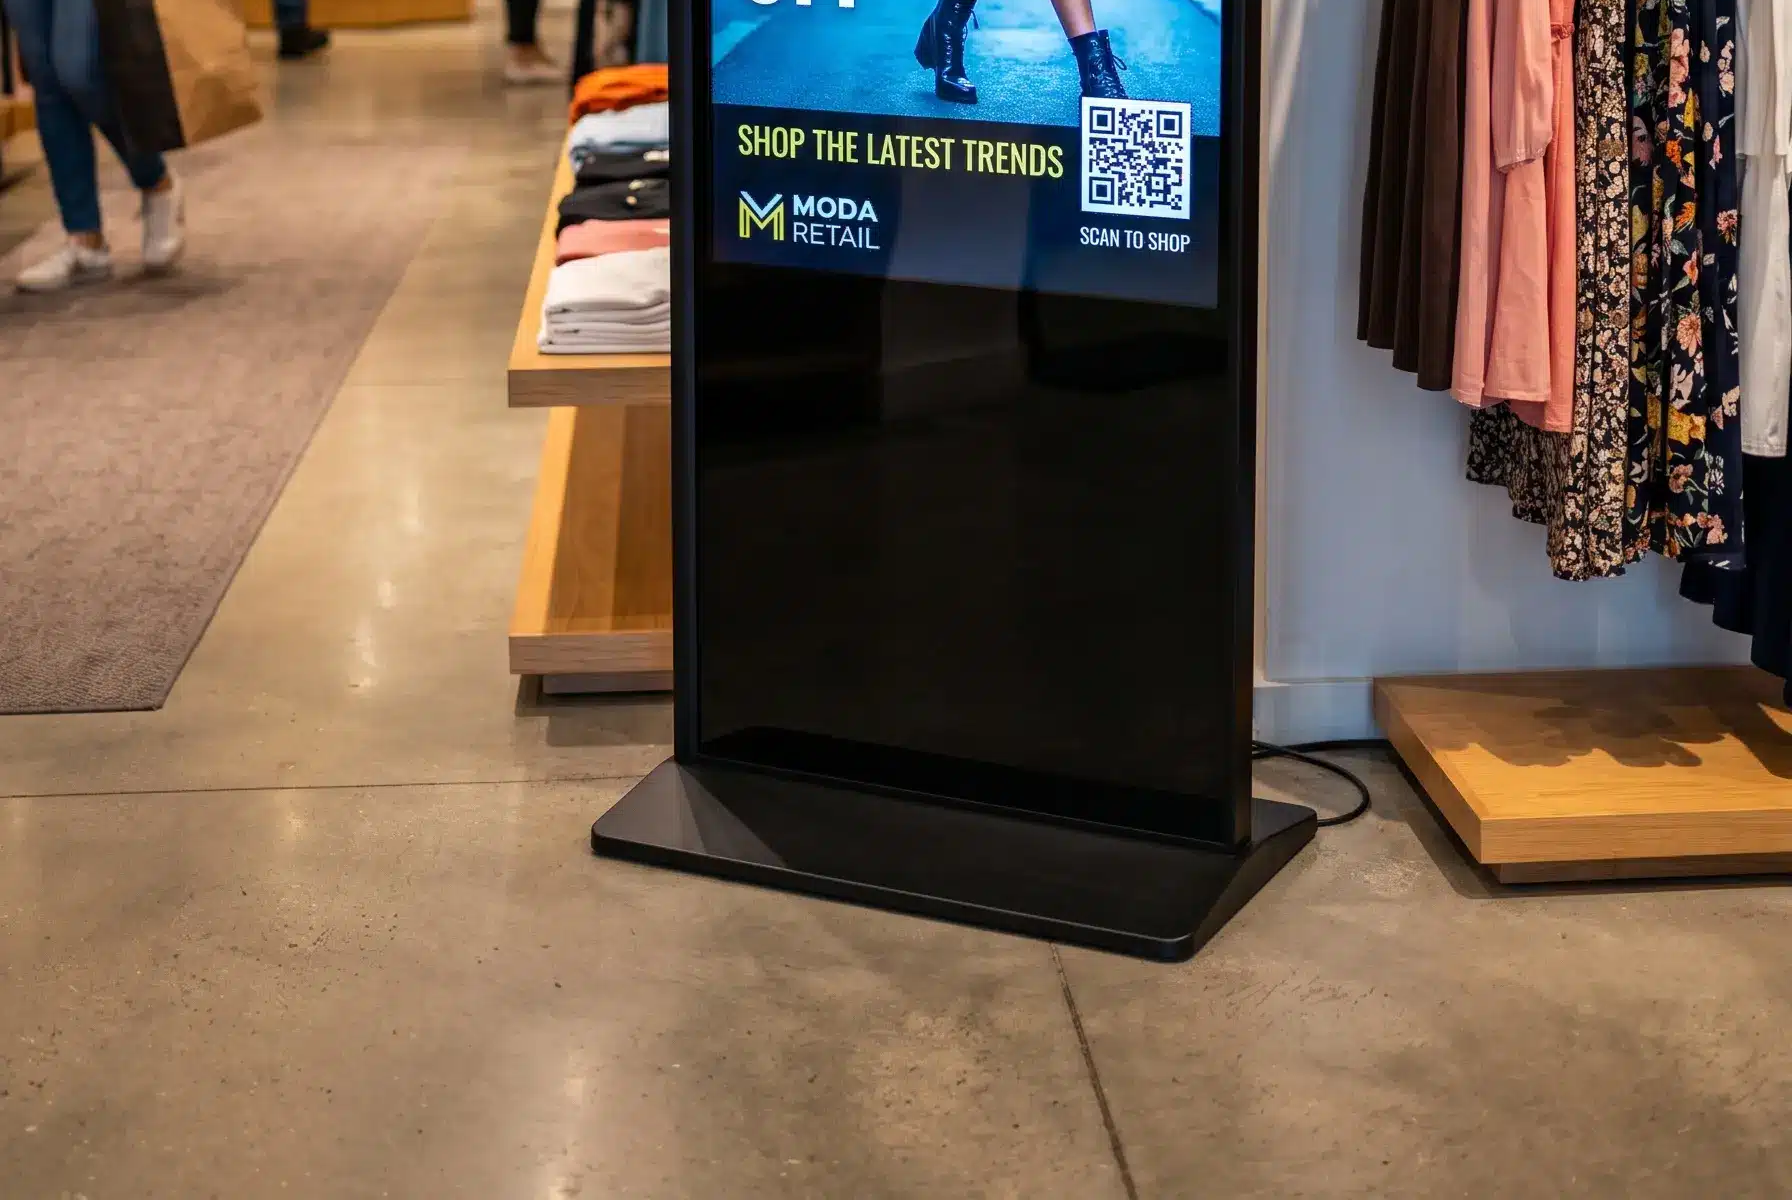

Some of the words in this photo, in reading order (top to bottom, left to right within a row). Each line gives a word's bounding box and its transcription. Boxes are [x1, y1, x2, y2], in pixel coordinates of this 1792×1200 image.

[738, 124, 805, 159] SHOP
[813, 129, 858, 164] THE
[867, 134, 955, 170] LATEST
[963, 139, 1063, 179] TRENDS
[793, 194, 878, 222] MODA
[792, 222, 880, 250] RETAIL
[1079, 225, 1120, 248] SCAN
[1124, 229, 1144, 249] TO
[1147, 231, 1191, 253] SHOP
